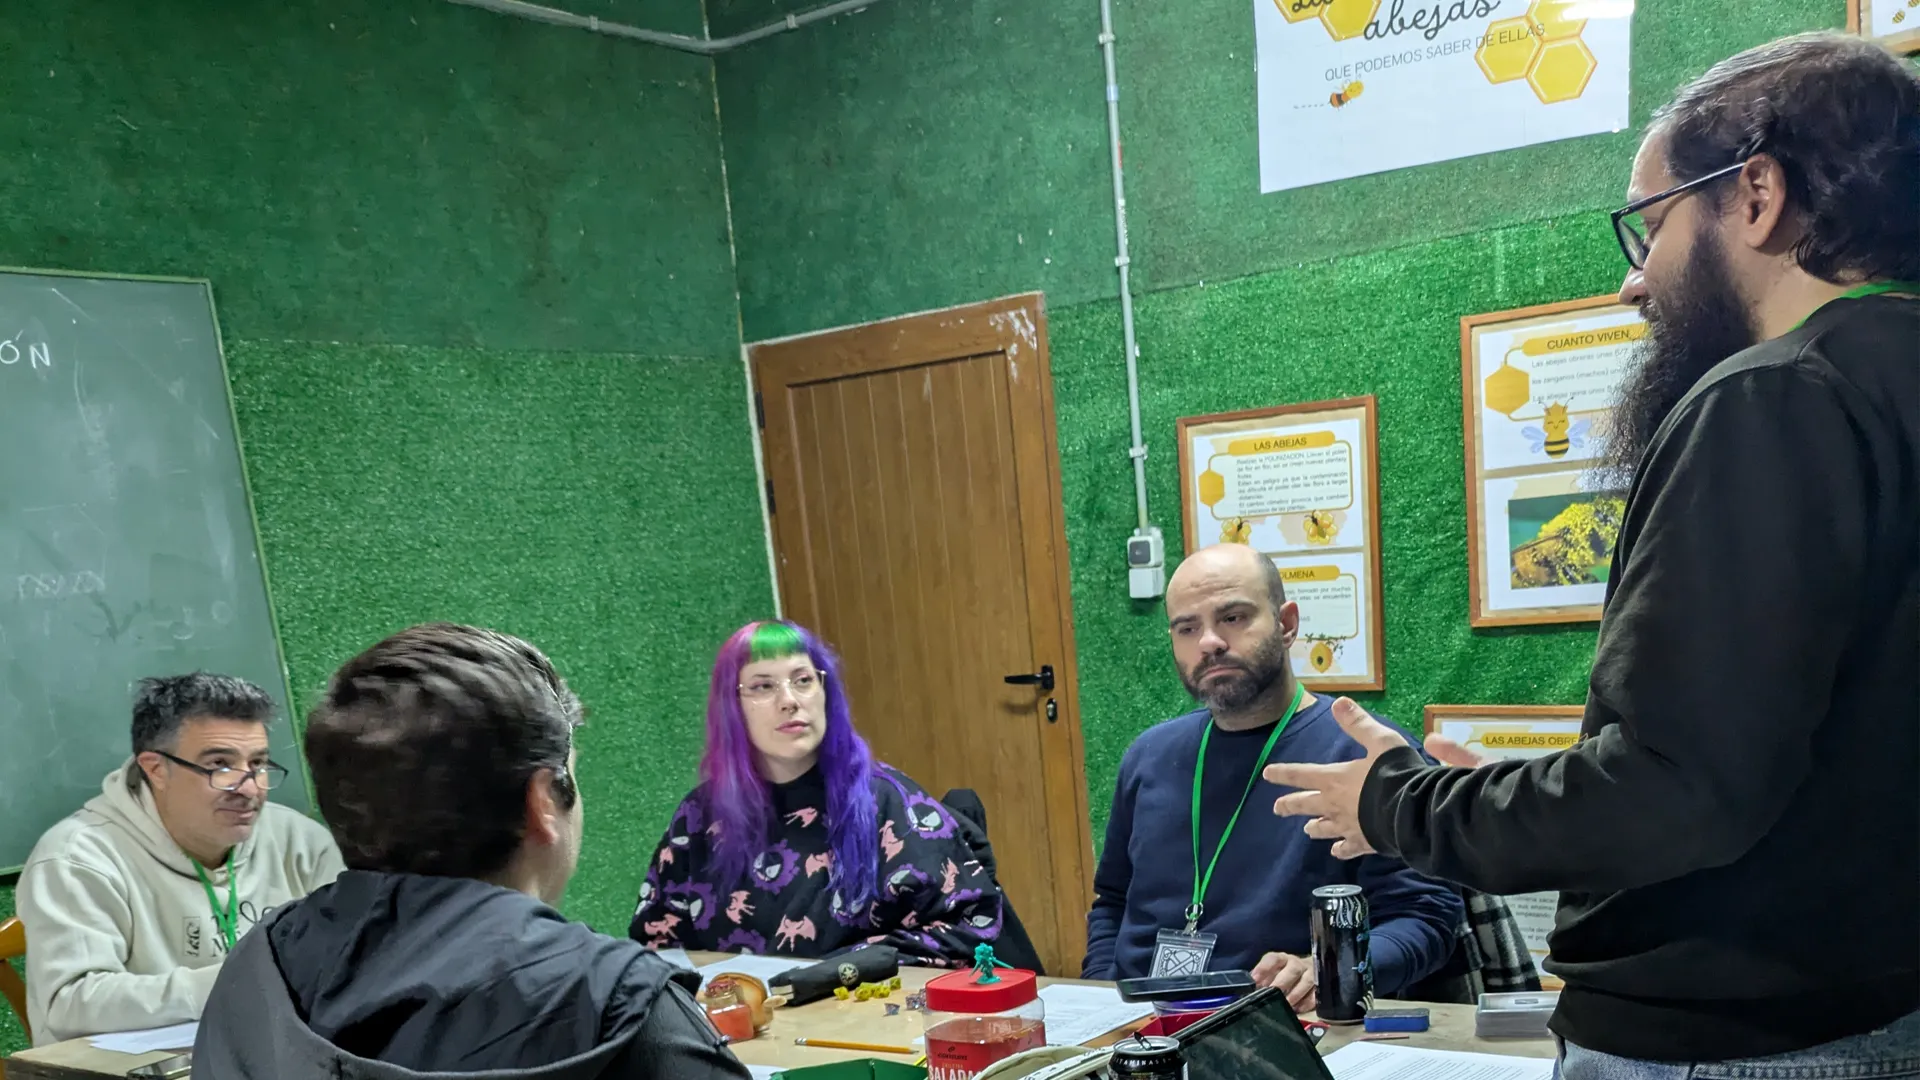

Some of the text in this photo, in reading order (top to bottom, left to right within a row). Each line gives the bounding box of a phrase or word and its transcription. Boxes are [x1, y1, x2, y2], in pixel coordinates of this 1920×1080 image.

[1364, 0, 1502, 41] abejas
[1324, 23, 1545, 81] QUE PODEMOS SABER DE ELLAS
[1547, 330, 1629, 350] CUANTO VIVEN
[1254, 437, 1307, 452] LAS ABEJAS
[1280, 570, 1315, 580] OLMENA
[1485, 736, 1578, 745] LAS ABEJAS OBRE
[928, 1064, 982, 1080] SALADA
